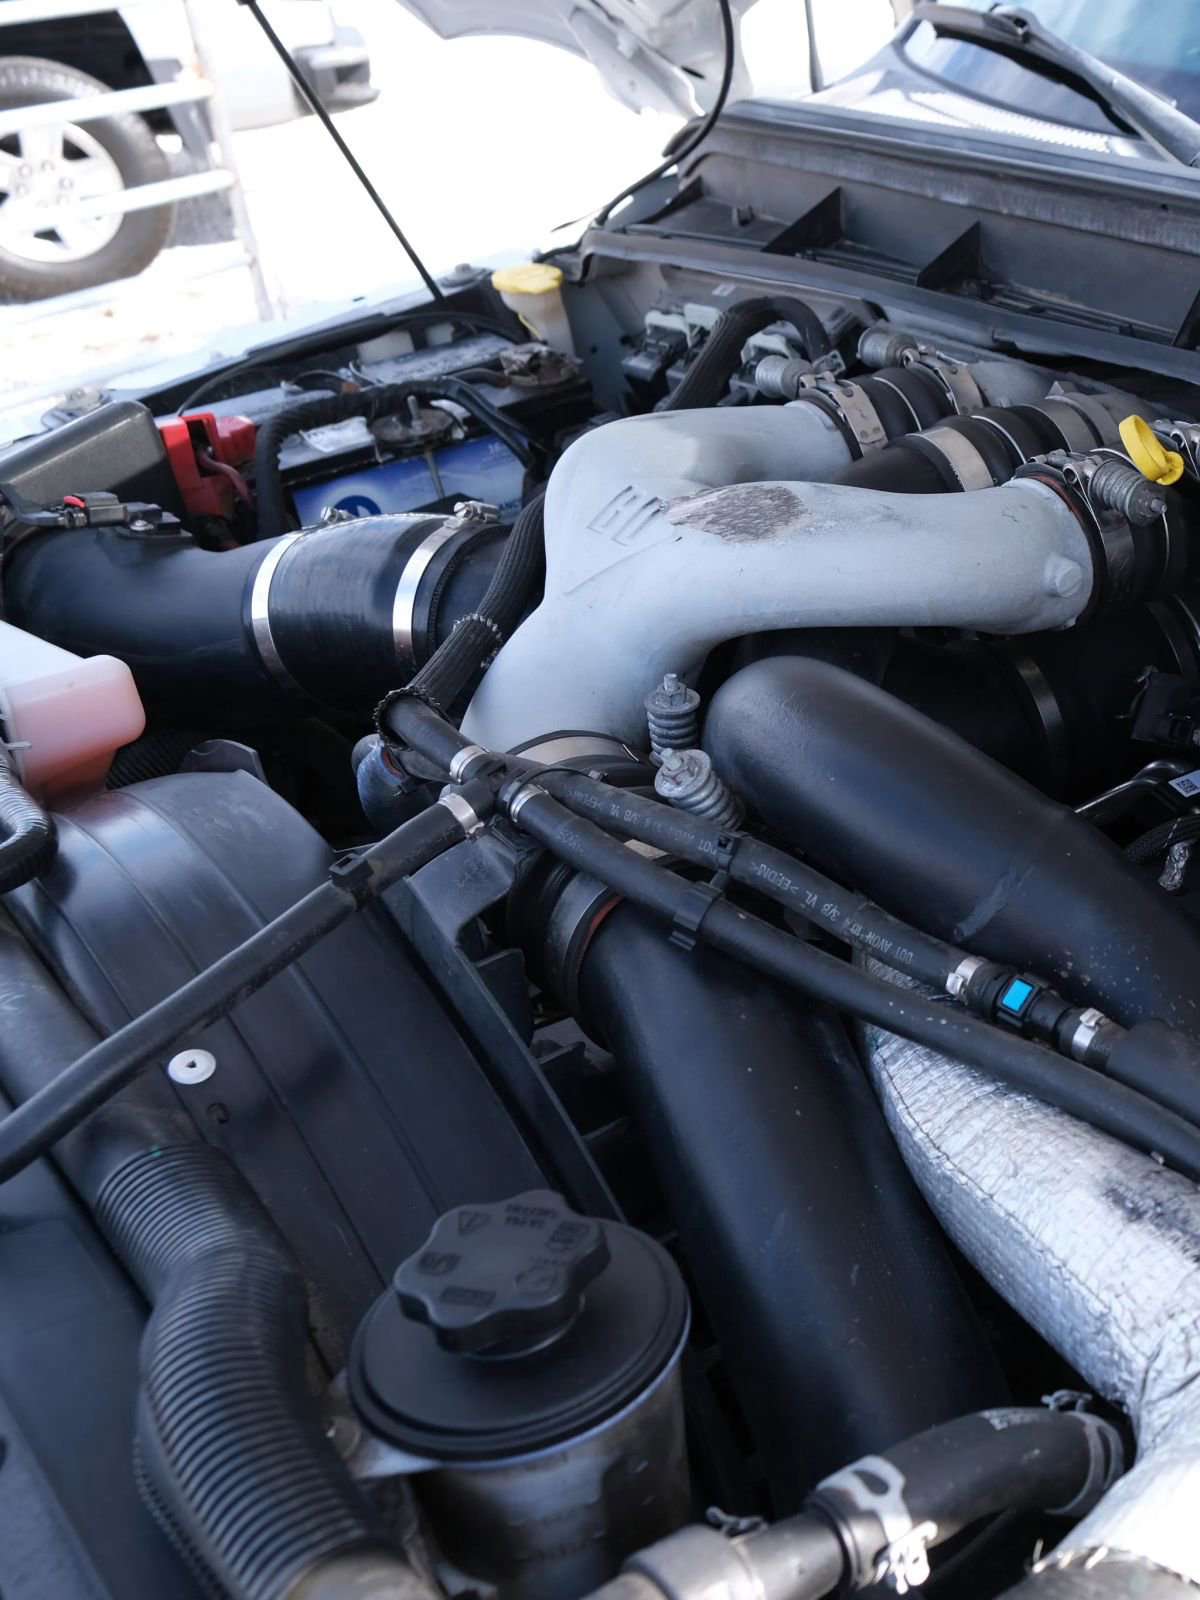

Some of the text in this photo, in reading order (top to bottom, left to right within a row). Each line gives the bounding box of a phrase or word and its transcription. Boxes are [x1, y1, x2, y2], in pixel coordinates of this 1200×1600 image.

[800, 888, 820, 909] VL
[819, 899, 844, 922] 3/8
[863, 930, 894, 954] AVON
[892, 944, 916, 965] DOT
